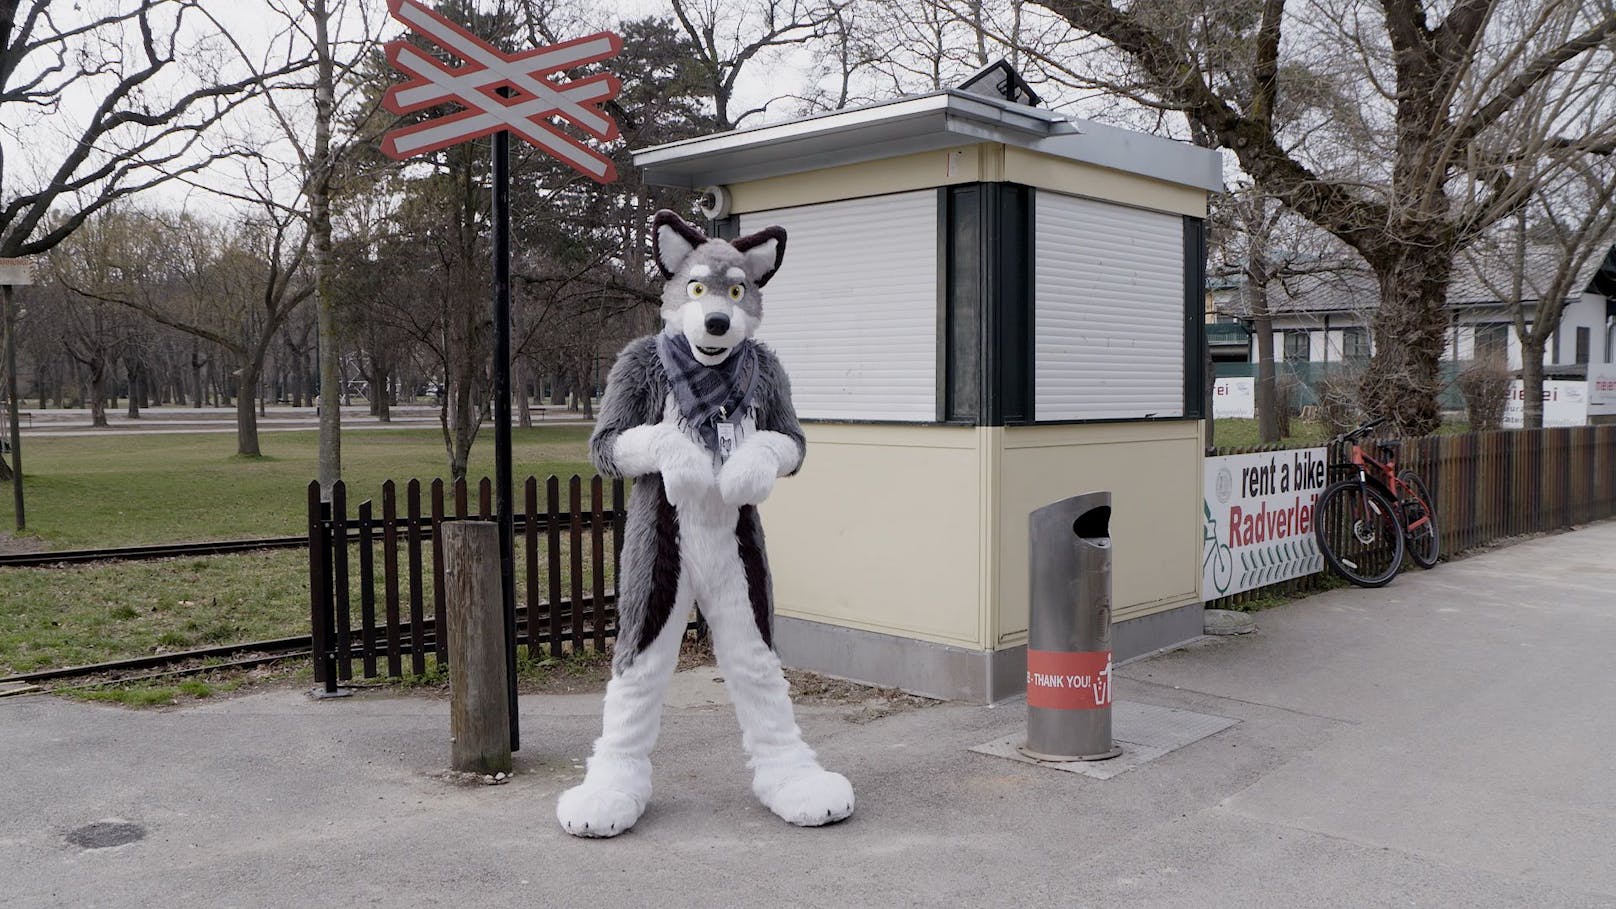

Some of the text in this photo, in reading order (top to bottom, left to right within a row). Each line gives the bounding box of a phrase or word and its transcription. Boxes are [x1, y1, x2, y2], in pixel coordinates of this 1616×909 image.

[1242, 451, 1324, 498] rent a bike
[1229, 493, 1318, 549] Radverlei
[1034, 673, 1064, 688] THANK
[1066, 675, 1091, 688] YOU!
